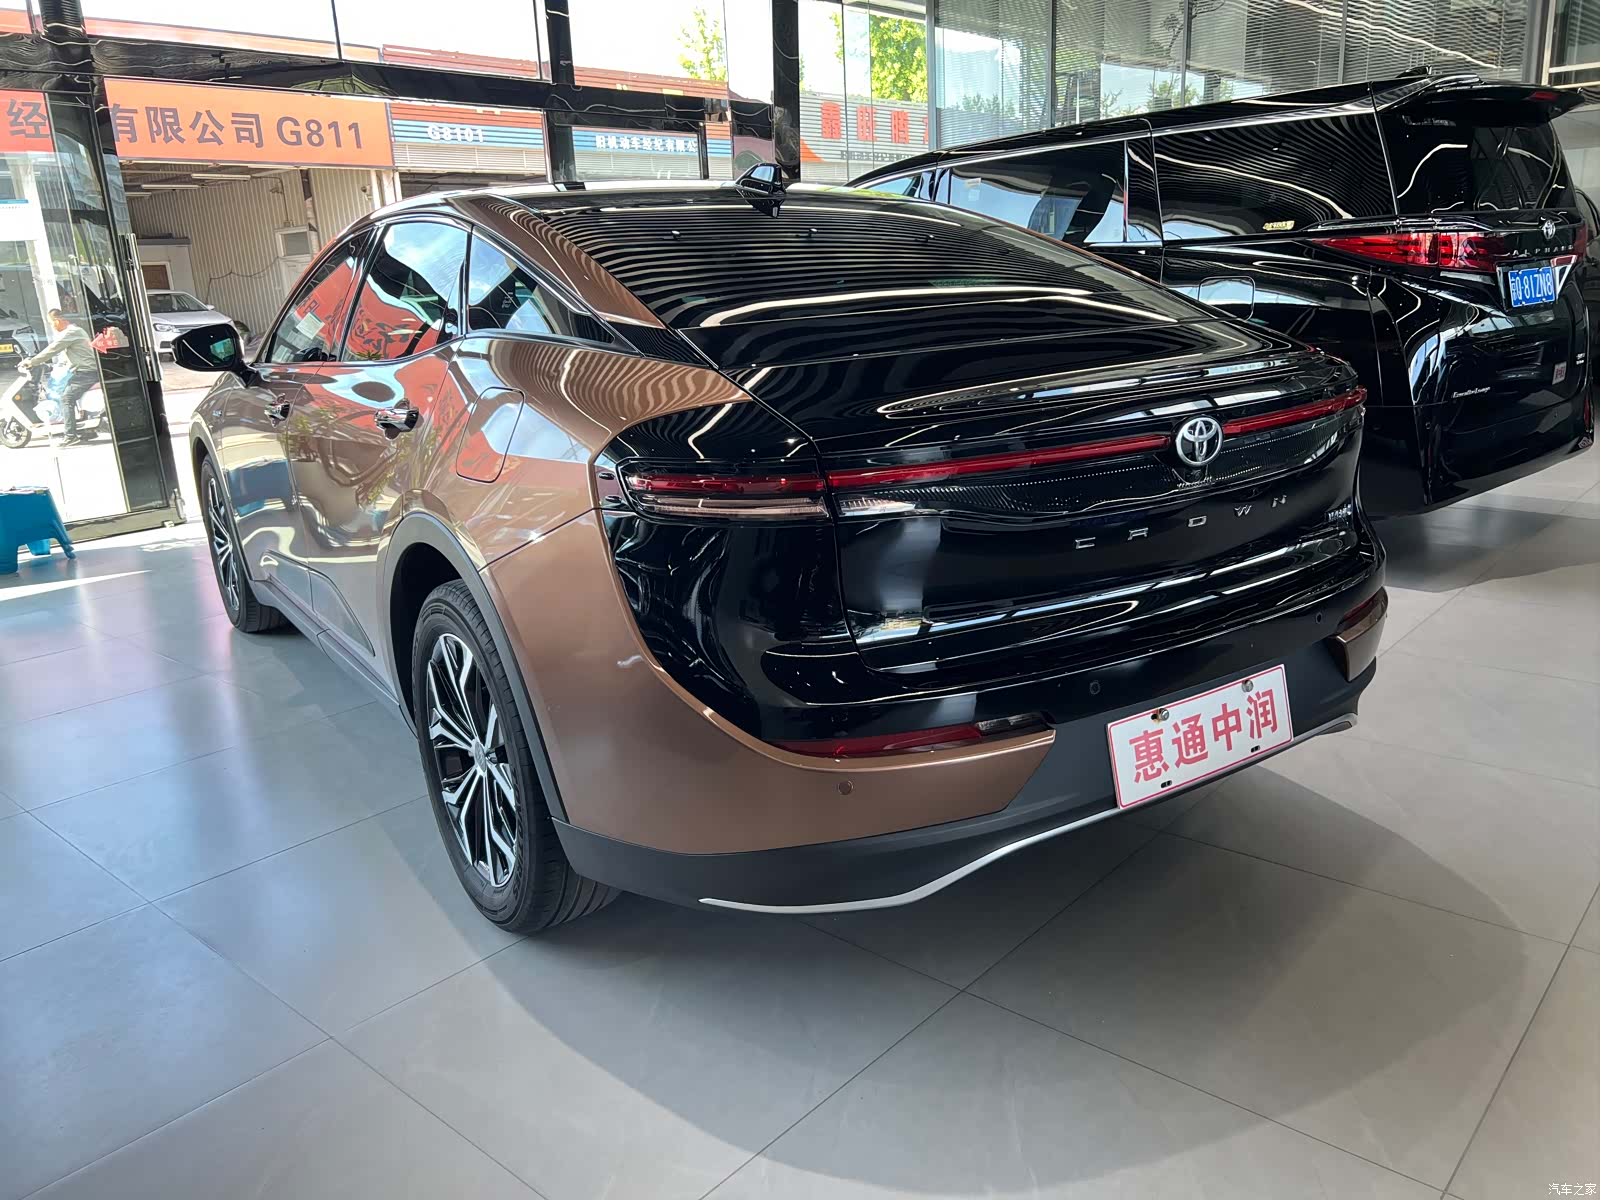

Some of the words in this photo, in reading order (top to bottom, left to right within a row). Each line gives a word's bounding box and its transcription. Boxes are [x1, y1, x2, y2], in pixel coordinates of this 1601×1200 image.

[110, 103, 264, 148] 有限公司
[276, 116, 363, 149] G811
[426, 124, 484, 143] G8101
[1074, 495, 1287, 549] CROWN
[1129, 688, 1278, 784] 惠通中润
